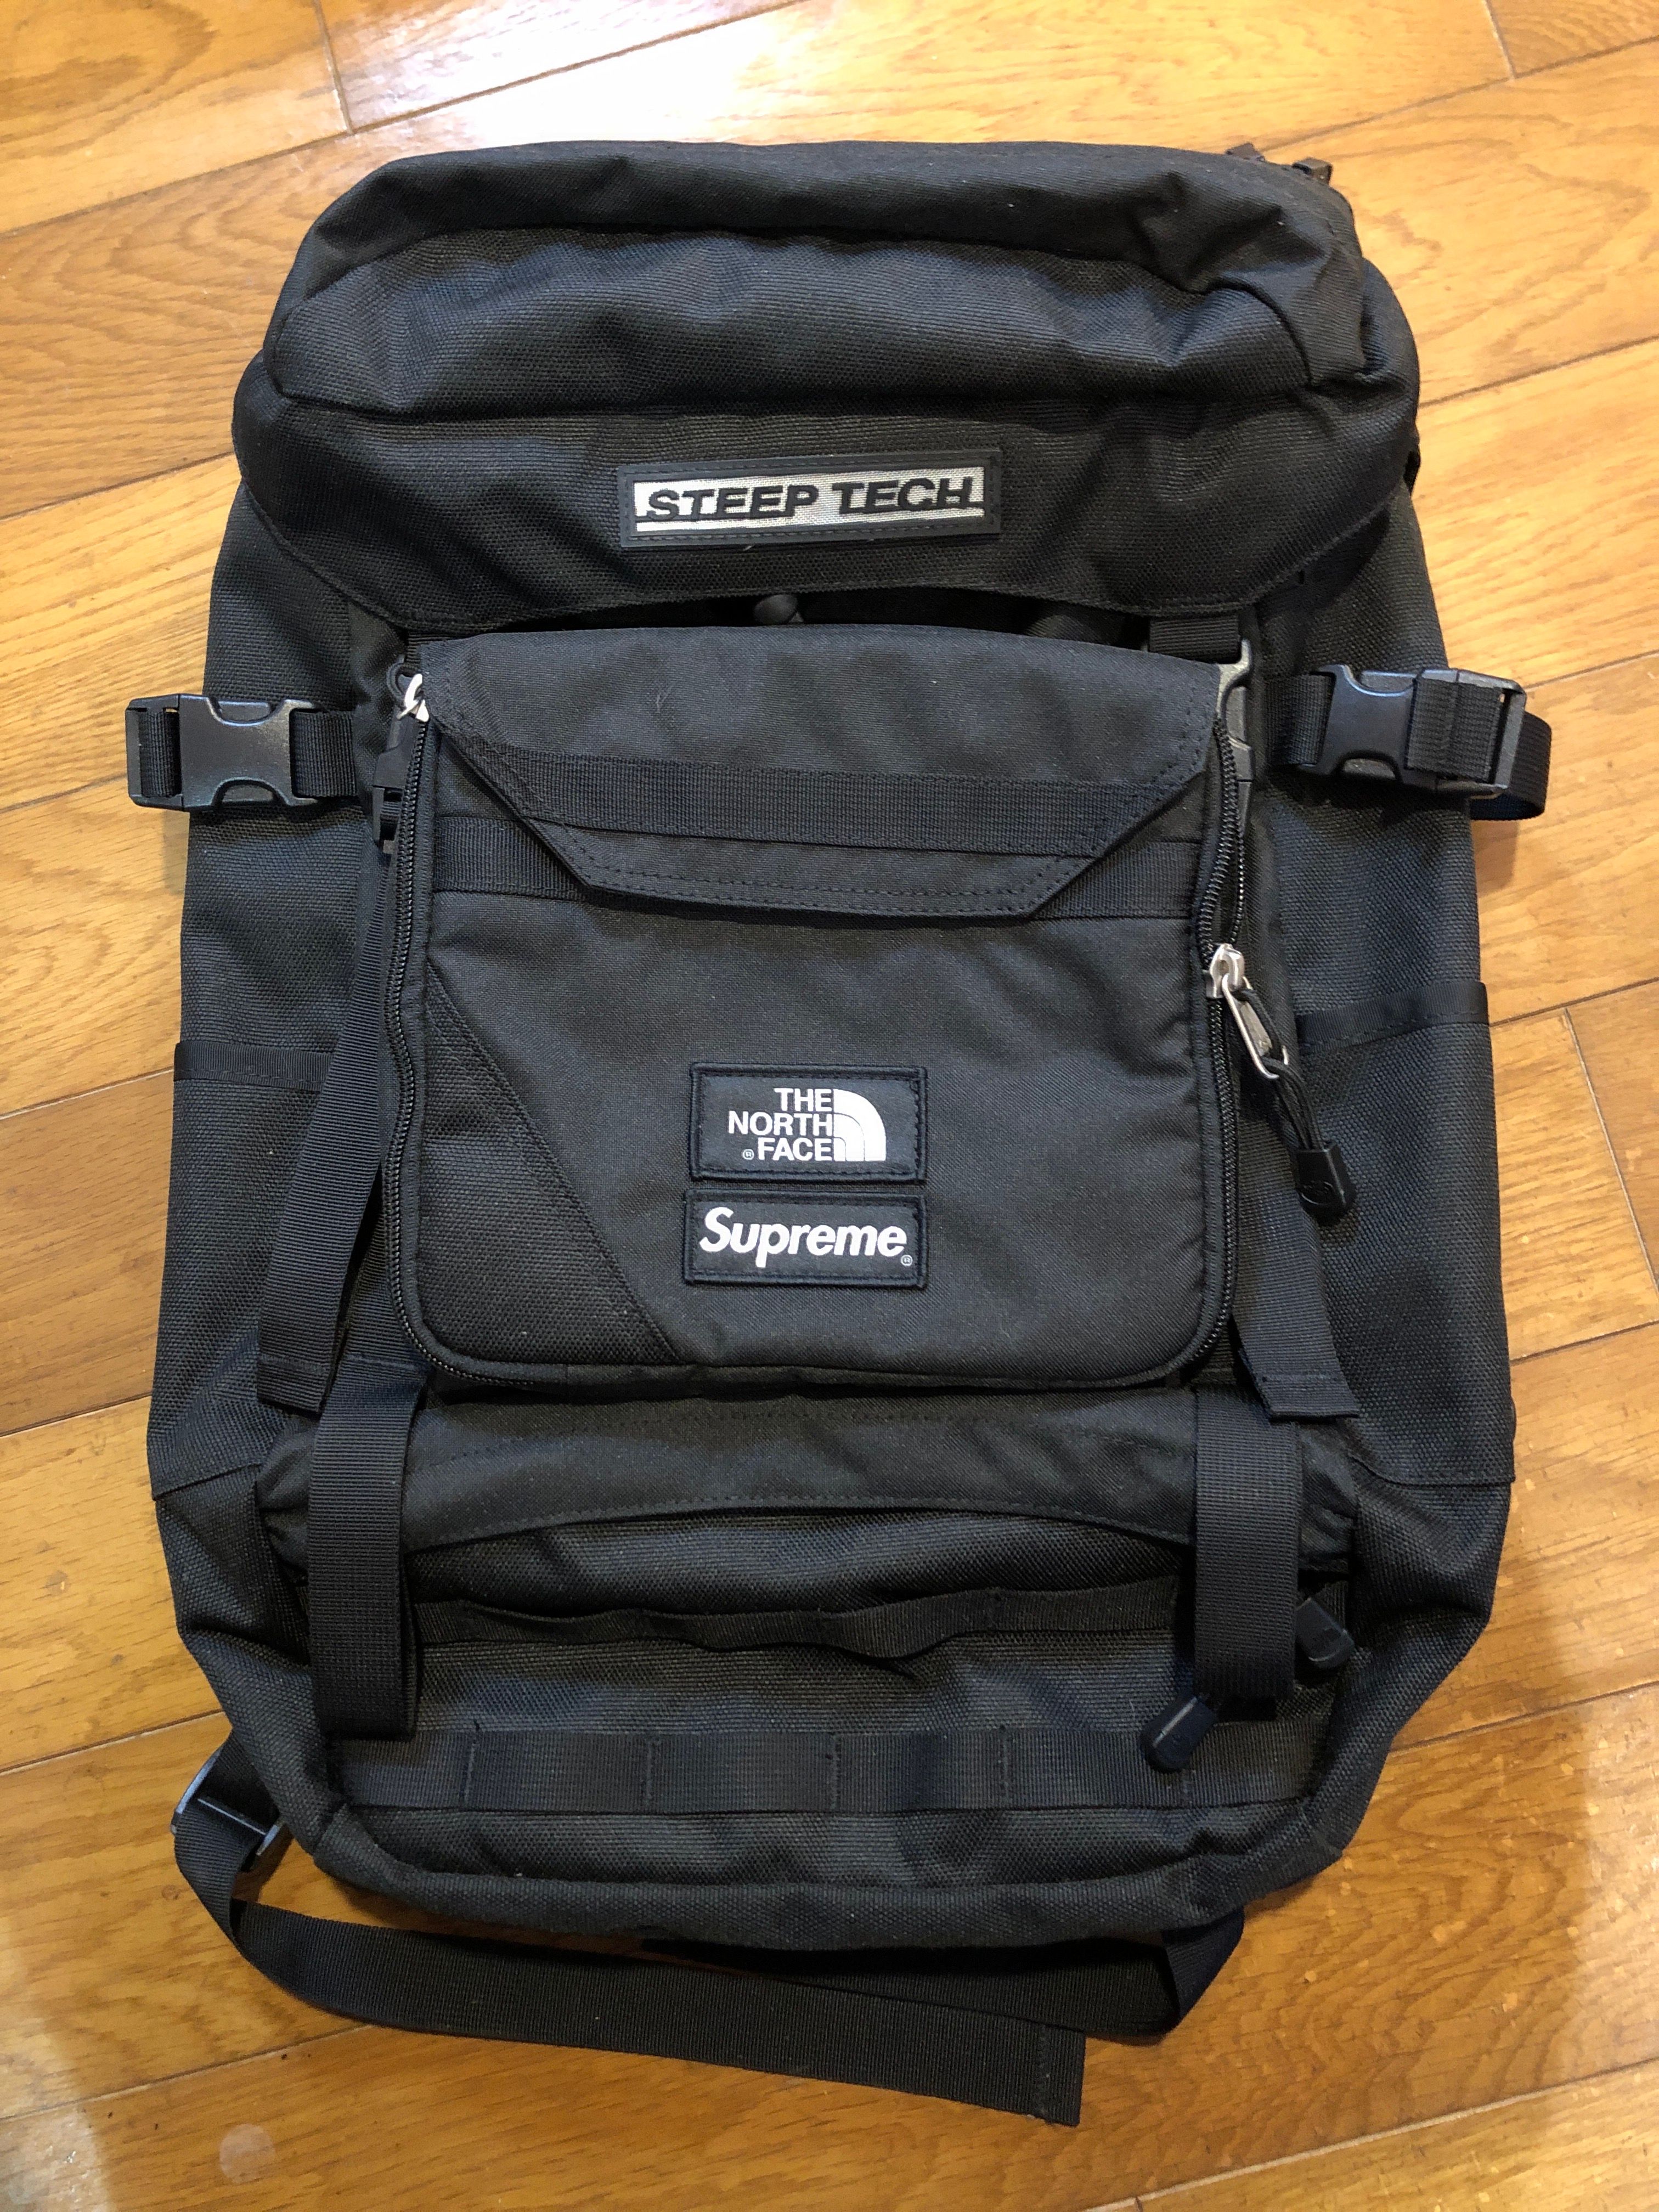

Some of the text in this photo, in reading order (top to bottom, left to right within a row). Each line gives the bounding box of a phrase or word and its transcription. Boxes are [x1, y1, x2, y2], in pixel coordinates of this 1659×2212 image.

[647, 476, 974, 522] STEEP TECH
[774, 1087, 832, 1112] THE
[728, 1110, 832, 1136] NORTH
